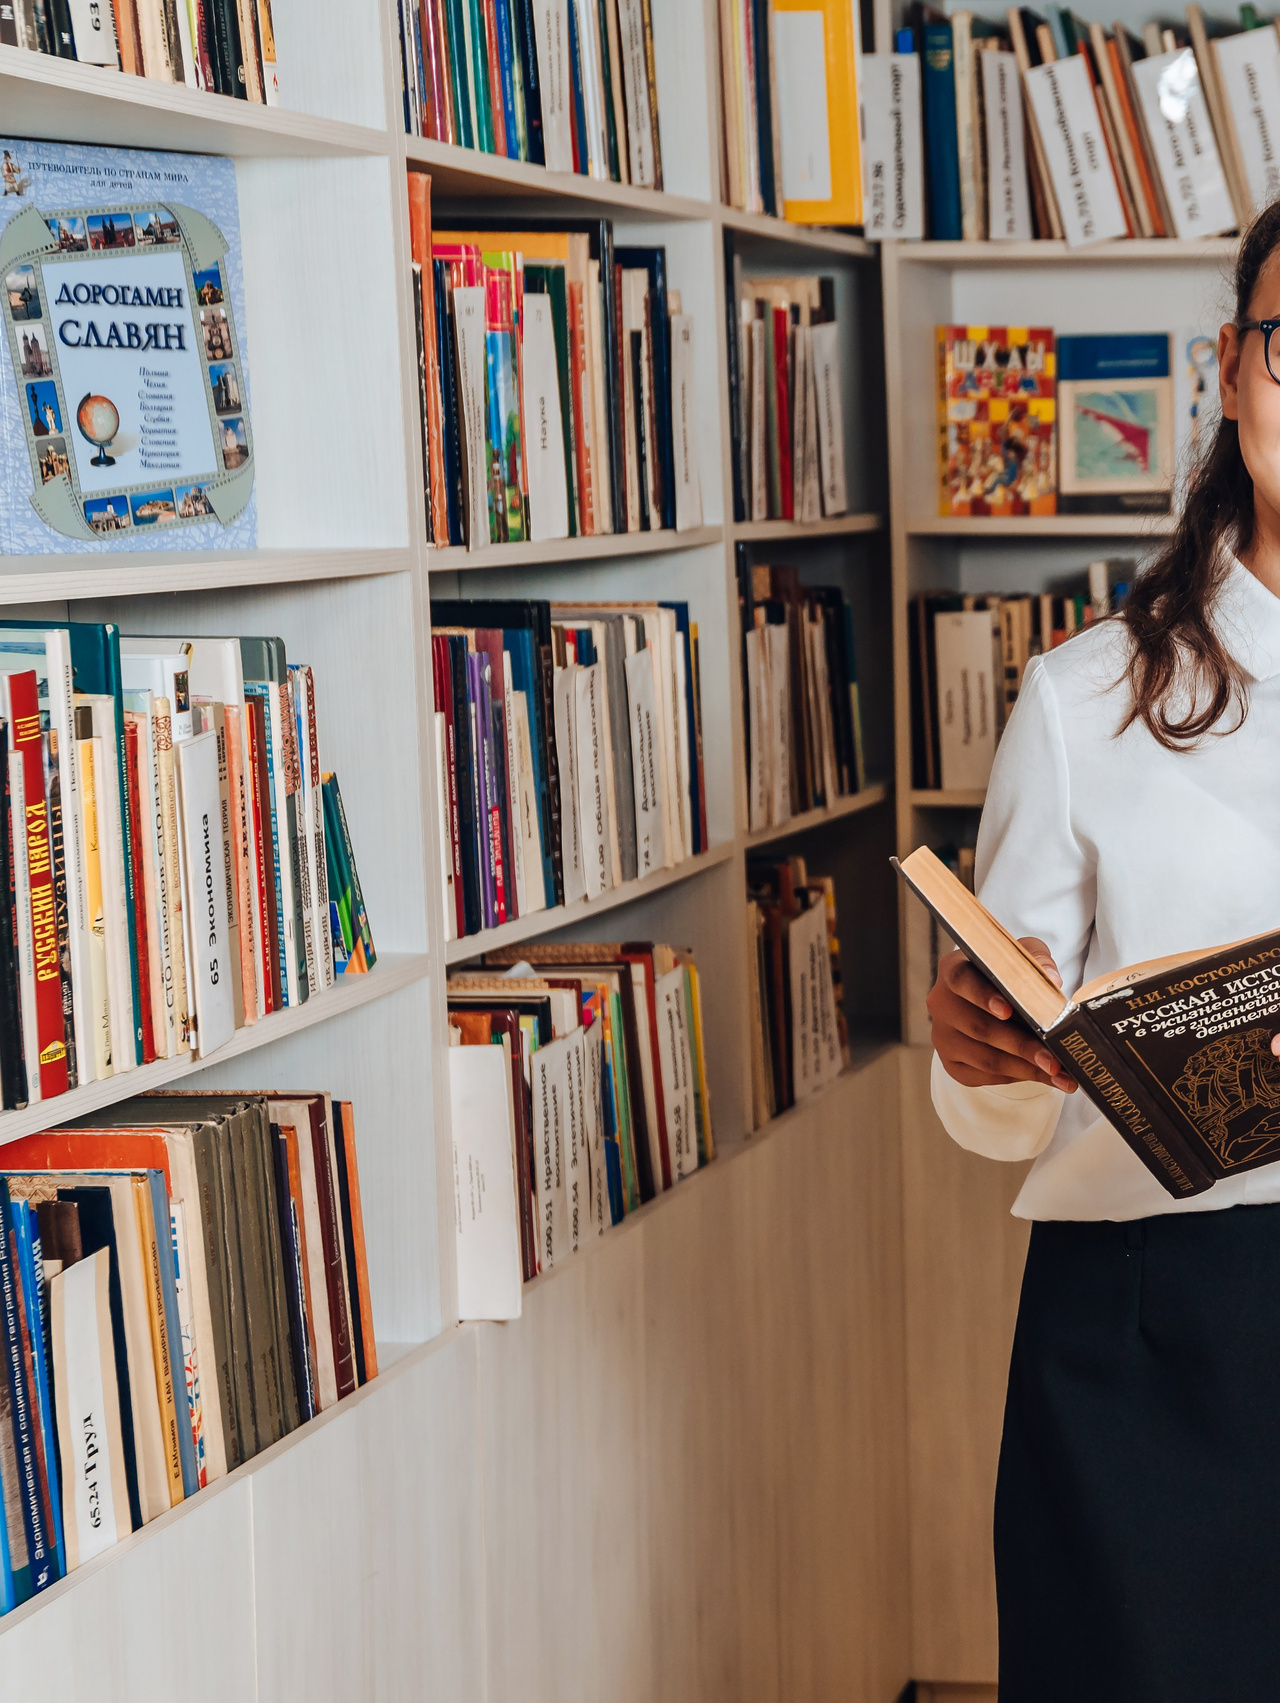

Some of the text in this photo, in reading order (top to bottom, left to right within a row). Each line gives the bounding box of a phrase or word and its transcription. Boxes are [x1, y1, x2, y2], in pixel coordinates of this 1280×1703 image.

[28, 162, 189, 182] ПУТЕВОДИТЕЛЬ ПО СТРАНАМ МИРА
[109, 181, 133, 189] детей
[59, 318, 188, 351] СЛАВЯН
[539, 397, 548, 450] Наука
[279, 682, 295, 795] ЭКОНОМИКА
[589, 669, 599, 769] педагогика
[636, 703, 649, 811] Дошкольное
[644, 710, 656, 807] воспитание
[594, 775, 603, 835] Общая
[25, 799, 58, 981] РУССКИЙ НАРОД
[51, 804, 68, 945] ГРУЗИНЫ
[201, 814, 219, 985] 65 Экономика
[221, 800, 234, 923] ЭКОНОМИЧЕСКАЯ ТЕОРИЯ
[166, 966, 174, 1007] СТО
[1111, 988, 1220, 1034] РУССКАЯ
[1125, 990, 1166, 1010] Н.И.
[1134, 1028, 1147, 1038] в
[1164, 1027, 1186, 1038] ее
[540, 1063, 552, 1190] Нравственное
[551, 1084, 561, 1187] воспитание
[566, 1051, 577, 1168] Эстетическое
[574, 1045, 584, 1147] воспитание
[1060, 1030, 1184, 1179] КОСТОМАРОВ РУССКАЯ ИСТОРИЯ
[151, 1241, 163, 1315] ПРОФЕССИЮ
[160, 1319, 169, 1377] ВЫБИРАТЬ
[3, 1264, 43, 1560] Экономическая и социальная география
[83, 1412, 102, 1528] 65.24 Труд
